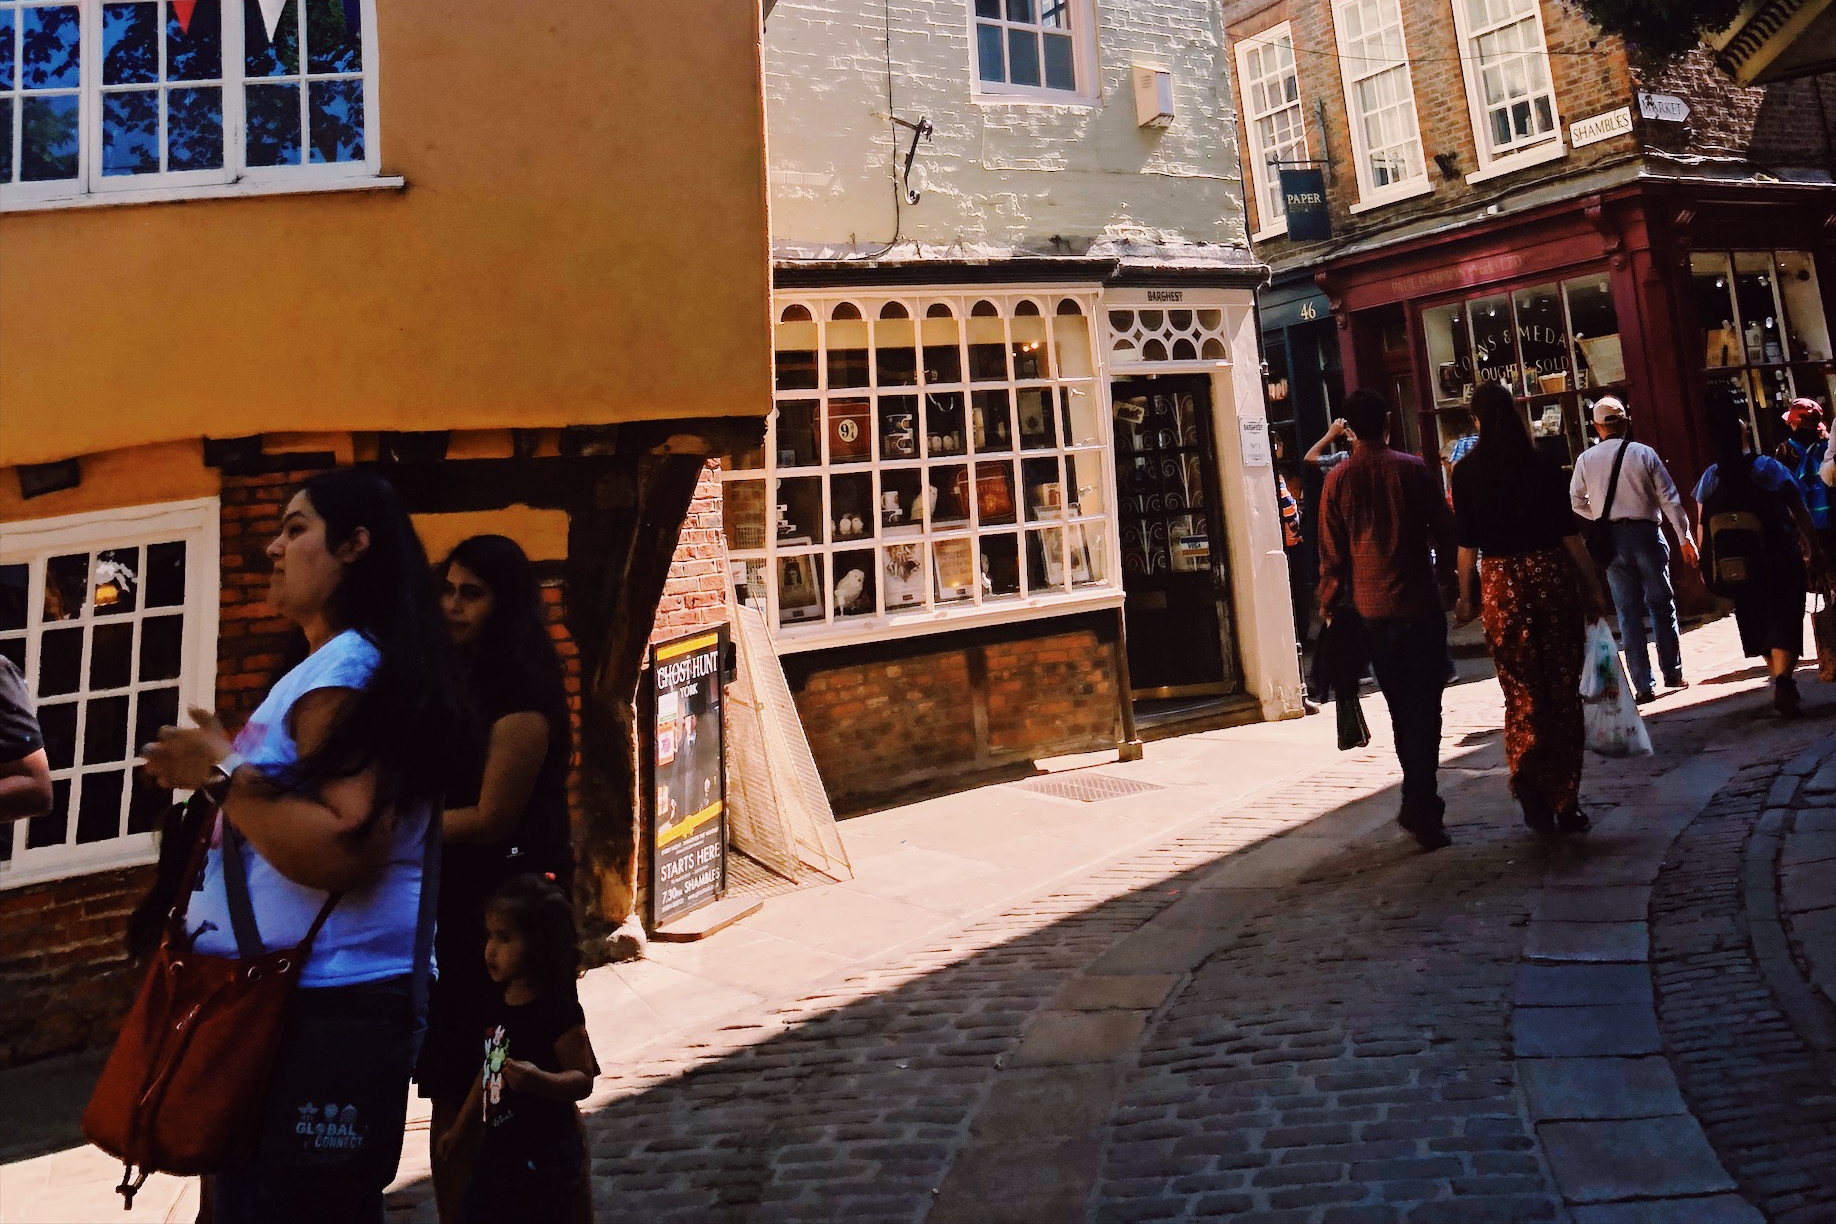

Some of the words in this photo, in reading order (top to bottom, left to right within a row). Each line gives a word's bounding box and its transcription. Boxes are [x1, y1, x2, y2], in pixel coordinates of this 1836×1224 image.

[1641, 99, 1681, 115] MARKET
[1573, 113, 1630, 141] SHAMBLES
[1286, 193, 1322, 205] PAPER
[1147, 291, 1183, 302] BARGHEST
[1300, 301, 1317, 321] 46
[1453, 334, 1497, 379] CONS
[1518, 325, 1567, 350] MEDA
[1479, 362, 1520, 382] OUGHT
[1536, 356, 1569, 374] SOLD
[657, 659, 691, 690] GHOST
[692, 650, 719, 679] HUNT
[679, 682, 699, 699] YORK
[660, 852, 695, 883] STARTS
[696, 842, 720, 867] HERE
[684, 867, 721, 894] SHAMBLES
[295, 1121, 357, 1137] GLOBAL
